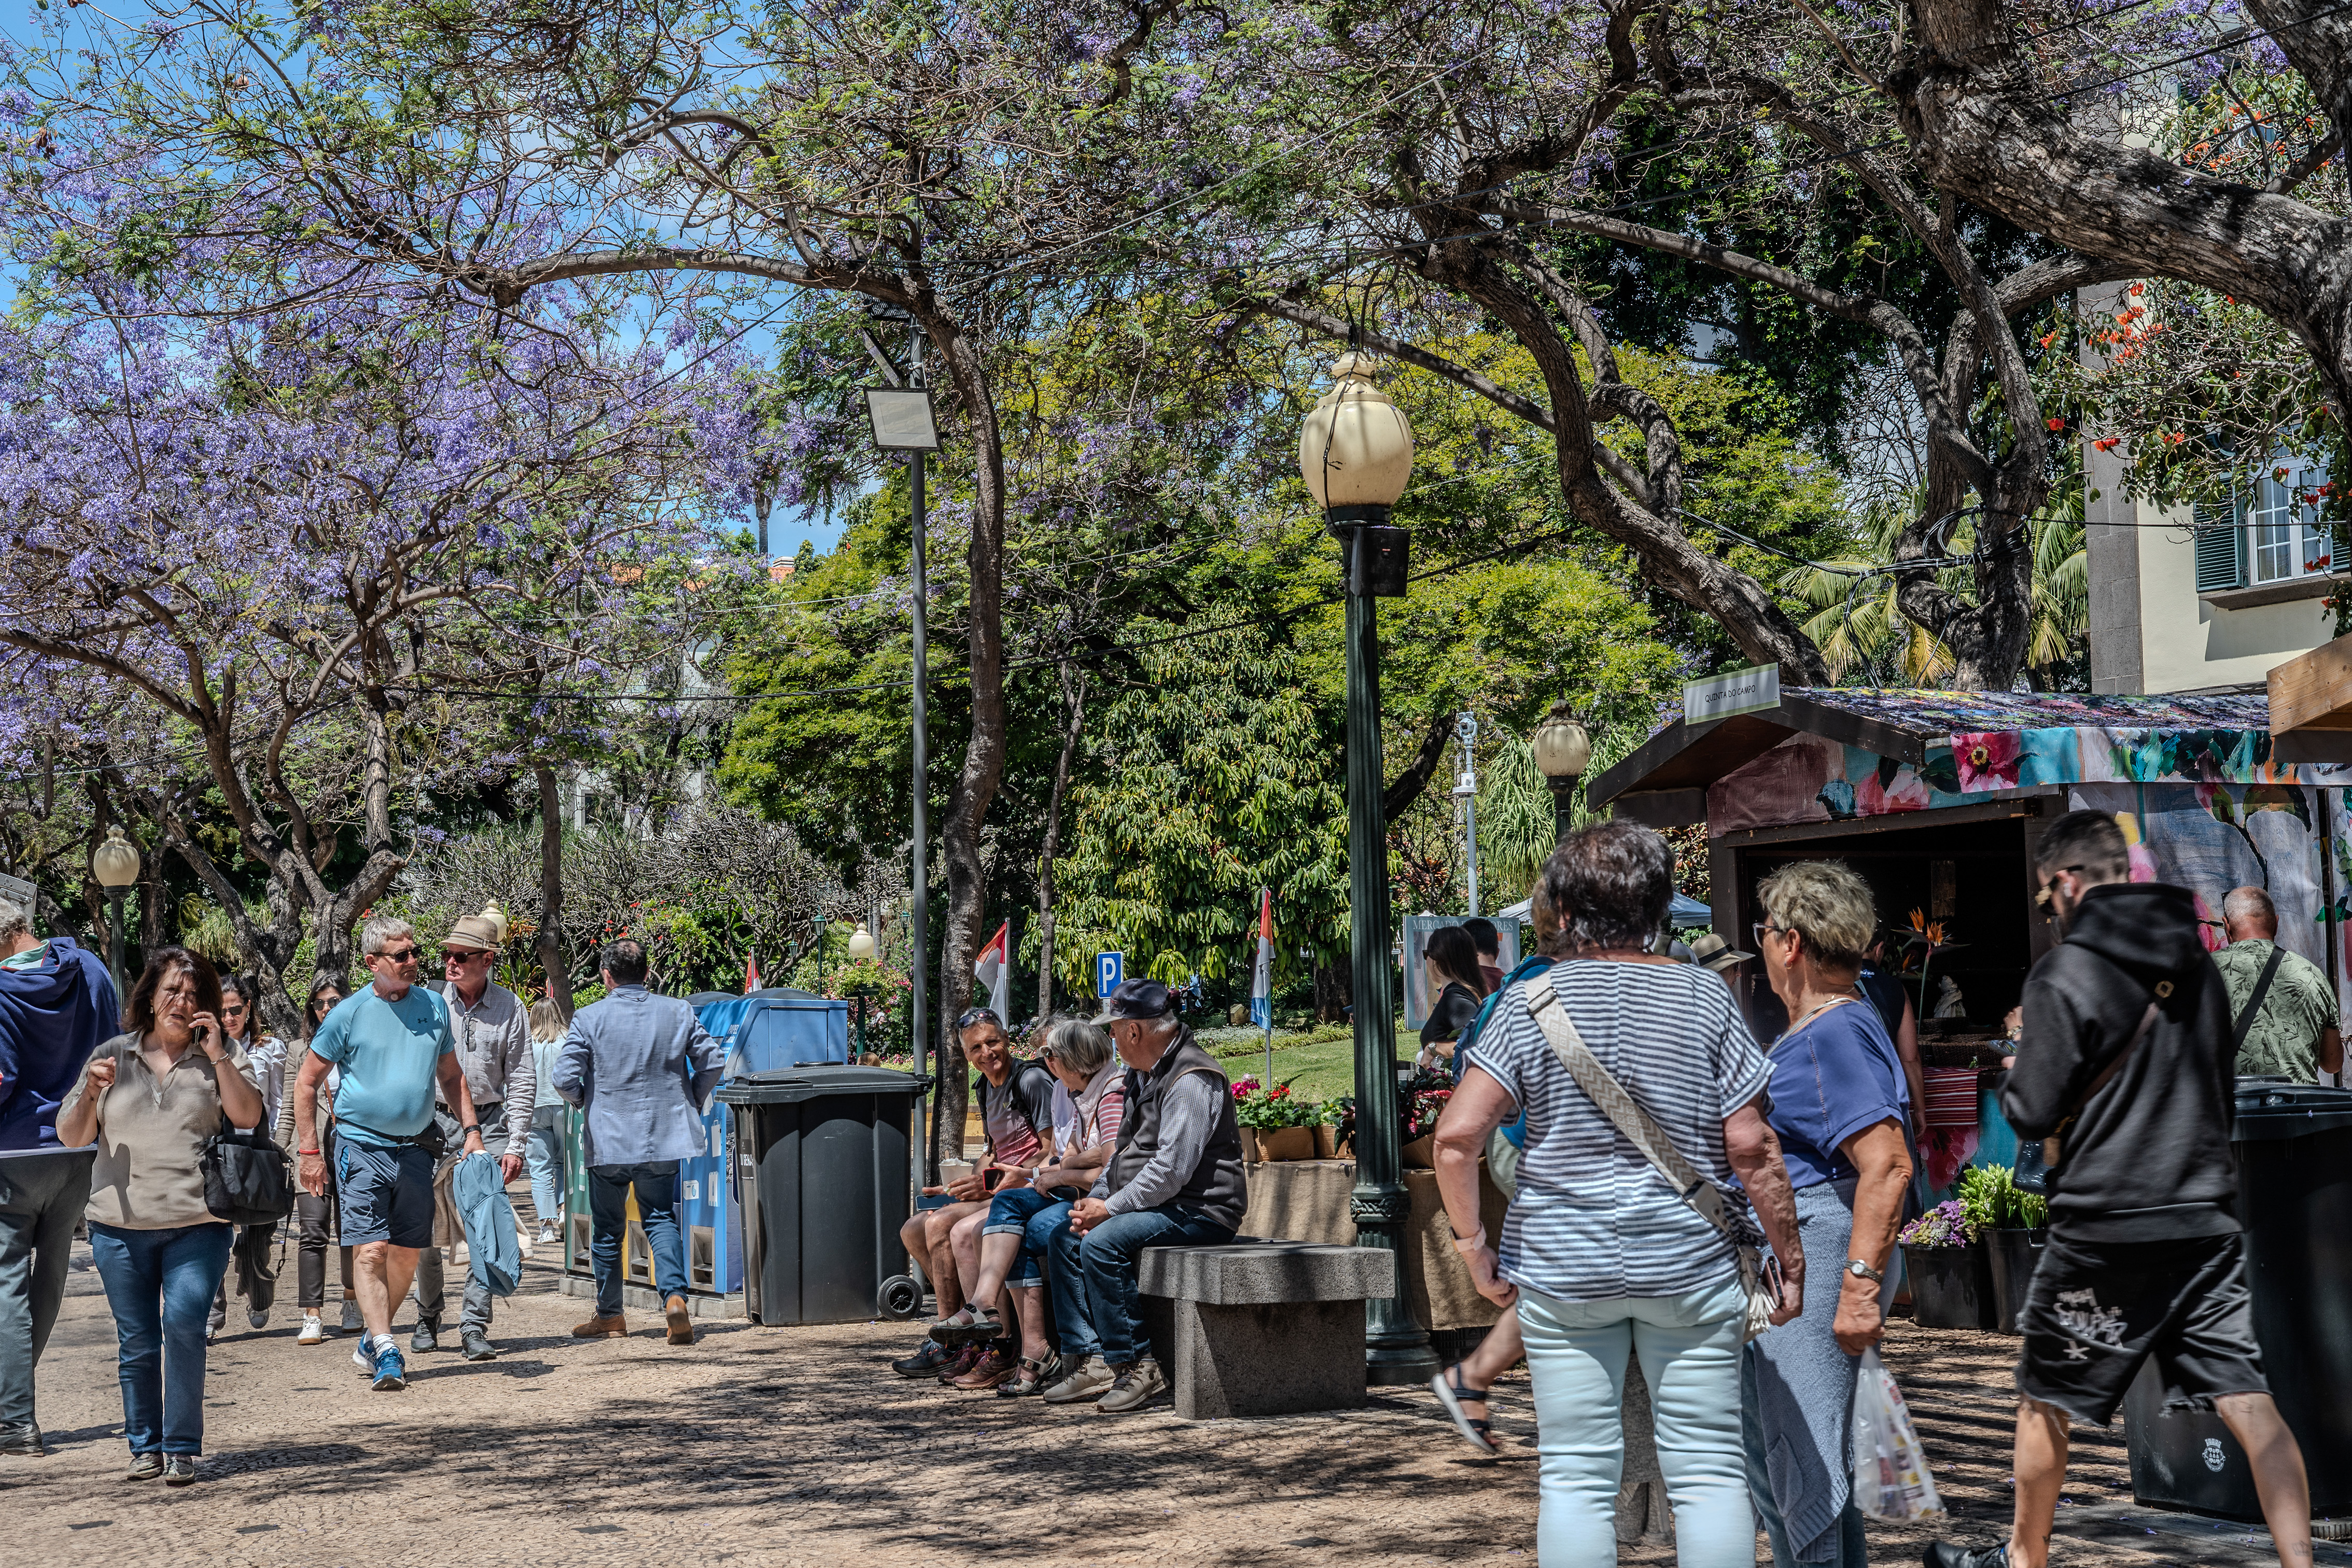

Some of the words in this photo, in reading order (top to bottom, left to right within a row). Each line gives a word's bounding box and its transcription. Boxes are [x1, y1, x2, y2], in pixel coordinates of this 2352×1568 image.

[1705, 691, 1727, 703] QUINTA
[1728, 689, 1736, 697] DO
[1737, 684, 1756, 695] CAMPO
[1413, 920, 1459, 930] MERCADO
[1491, 921, 1513, 931] ORES
[1102, 957, 1116, 993] P
